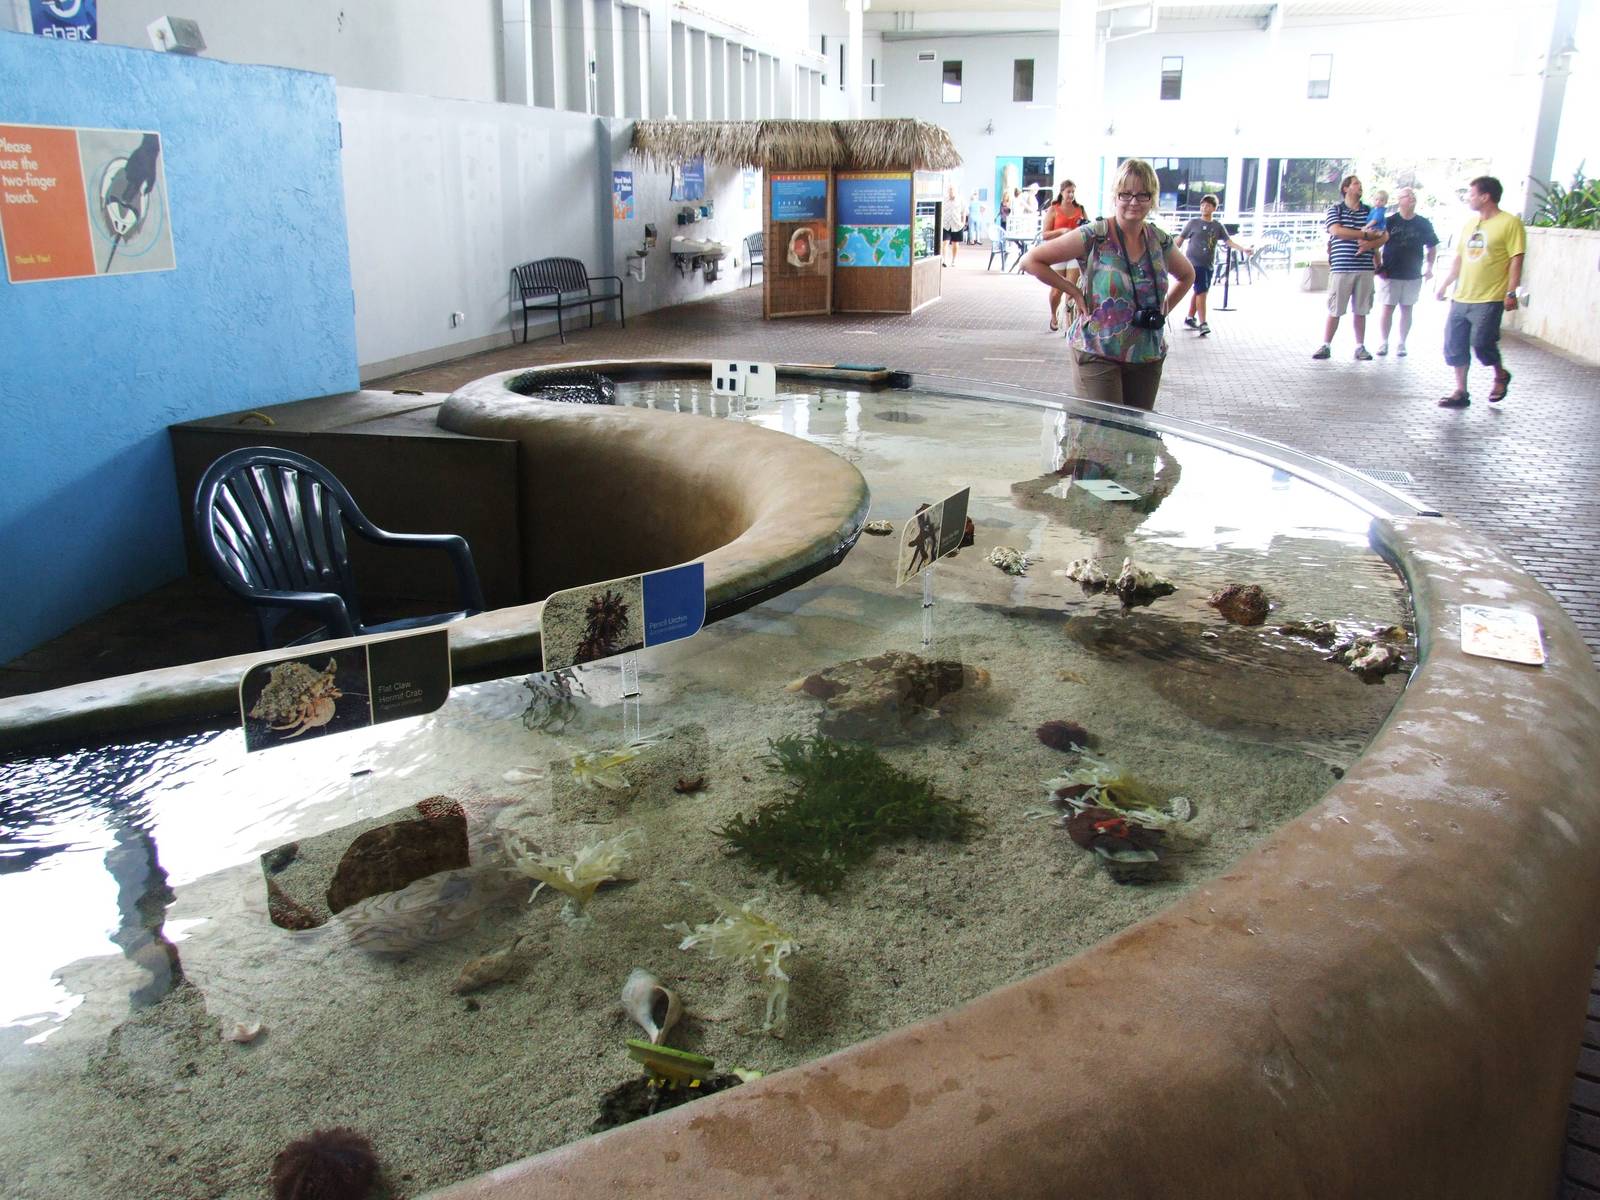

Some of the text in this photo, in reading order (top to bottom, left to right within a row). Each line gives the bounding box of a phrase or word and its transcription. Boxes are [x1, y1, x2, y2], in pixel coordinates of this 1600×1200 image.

[42, 24, 92, 40] shark
[0, 137, 32, 153] Please
[0, 155, 38, 170] use the
[1, 171, 57, 191] two-finger
[5, 189, 39, 204] touch.
[649, 617, 667, 629] Pencil
[668, 615, 688, 625] Urchin
[378, 682, 411, 693] Flat Claw
[378, 689, 423, 703] Hermit Crab
